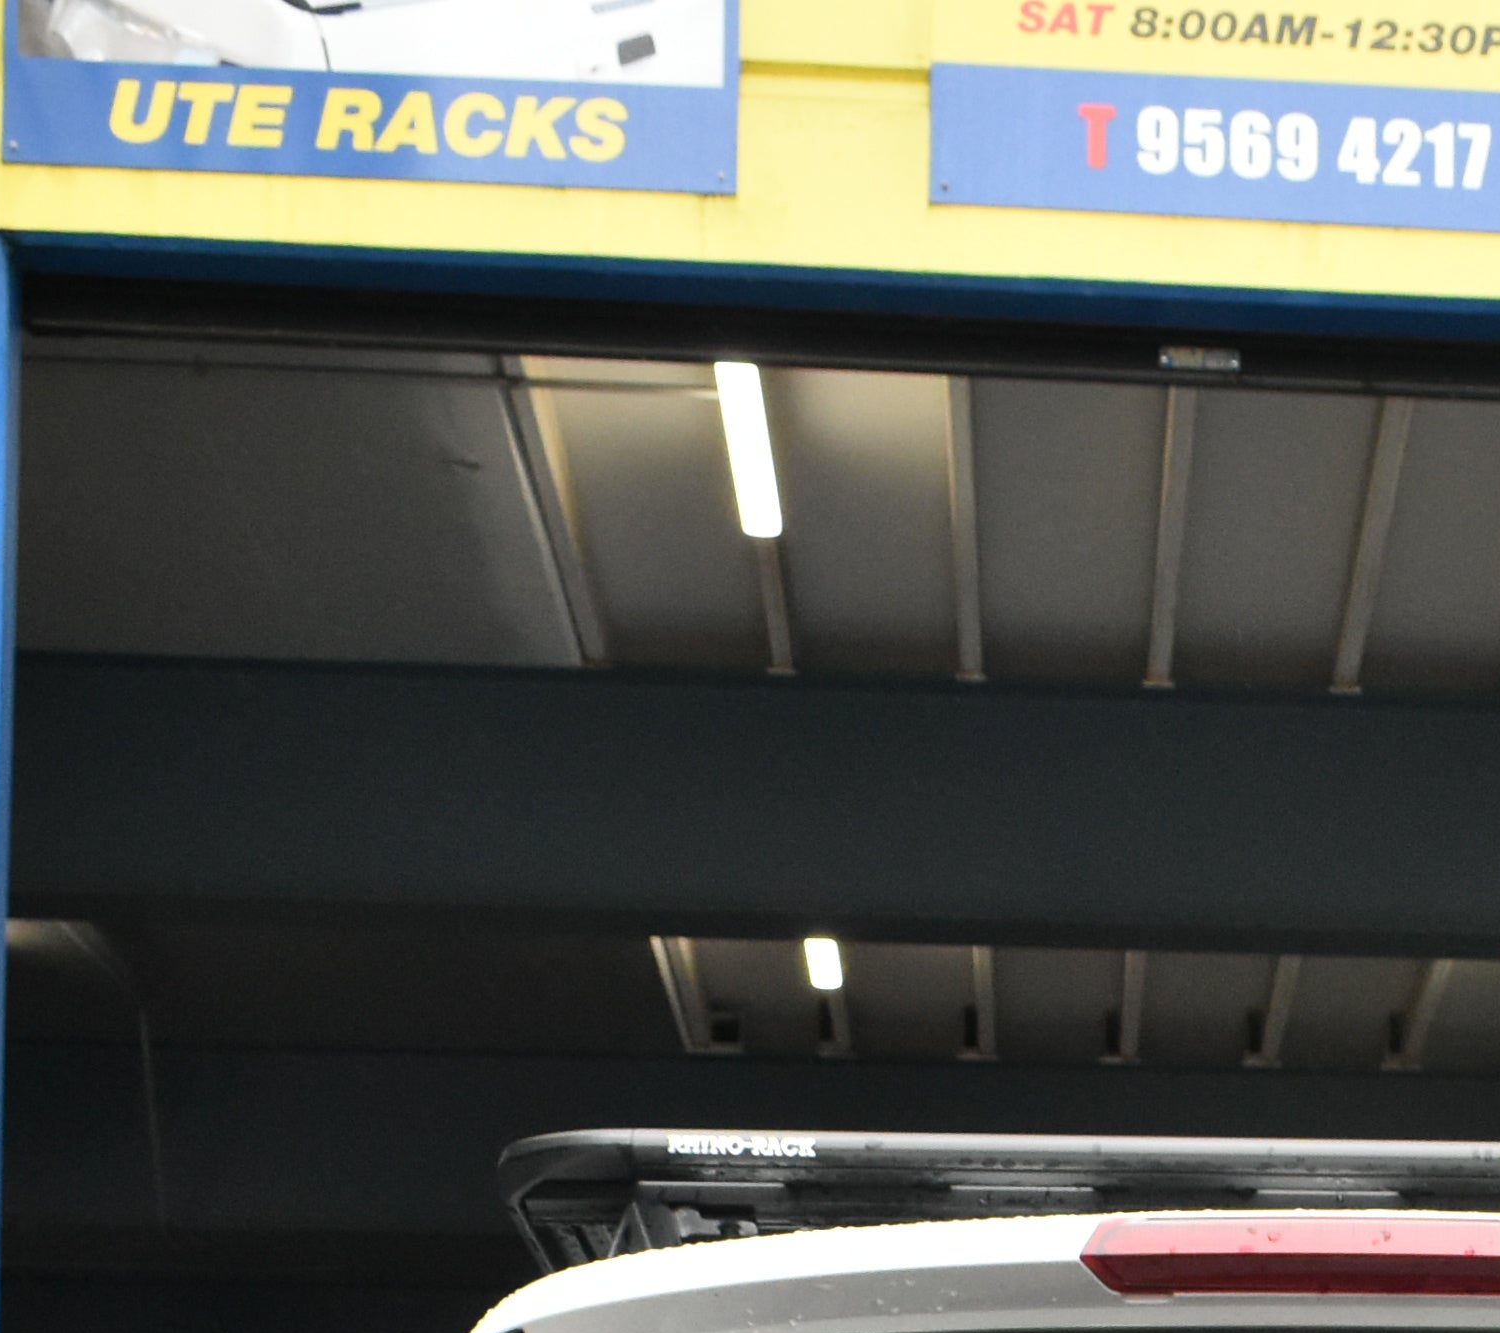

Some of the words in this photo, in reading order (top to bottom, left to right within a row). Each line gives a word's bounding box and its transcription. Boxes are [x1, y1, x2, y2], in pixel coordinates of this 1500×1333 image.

[1017, 0, 1114, 36] SAT
[108, 78, 293, 148] UTE
[315, 87, 630, 162] RACKS
[1078, 103, 1117, 170] T
[1136, 105, 1319, 182] 9569
[1337, 116, 1492, 190] 4217
[666, 1134, 817, 1158] RHINO-RACK
